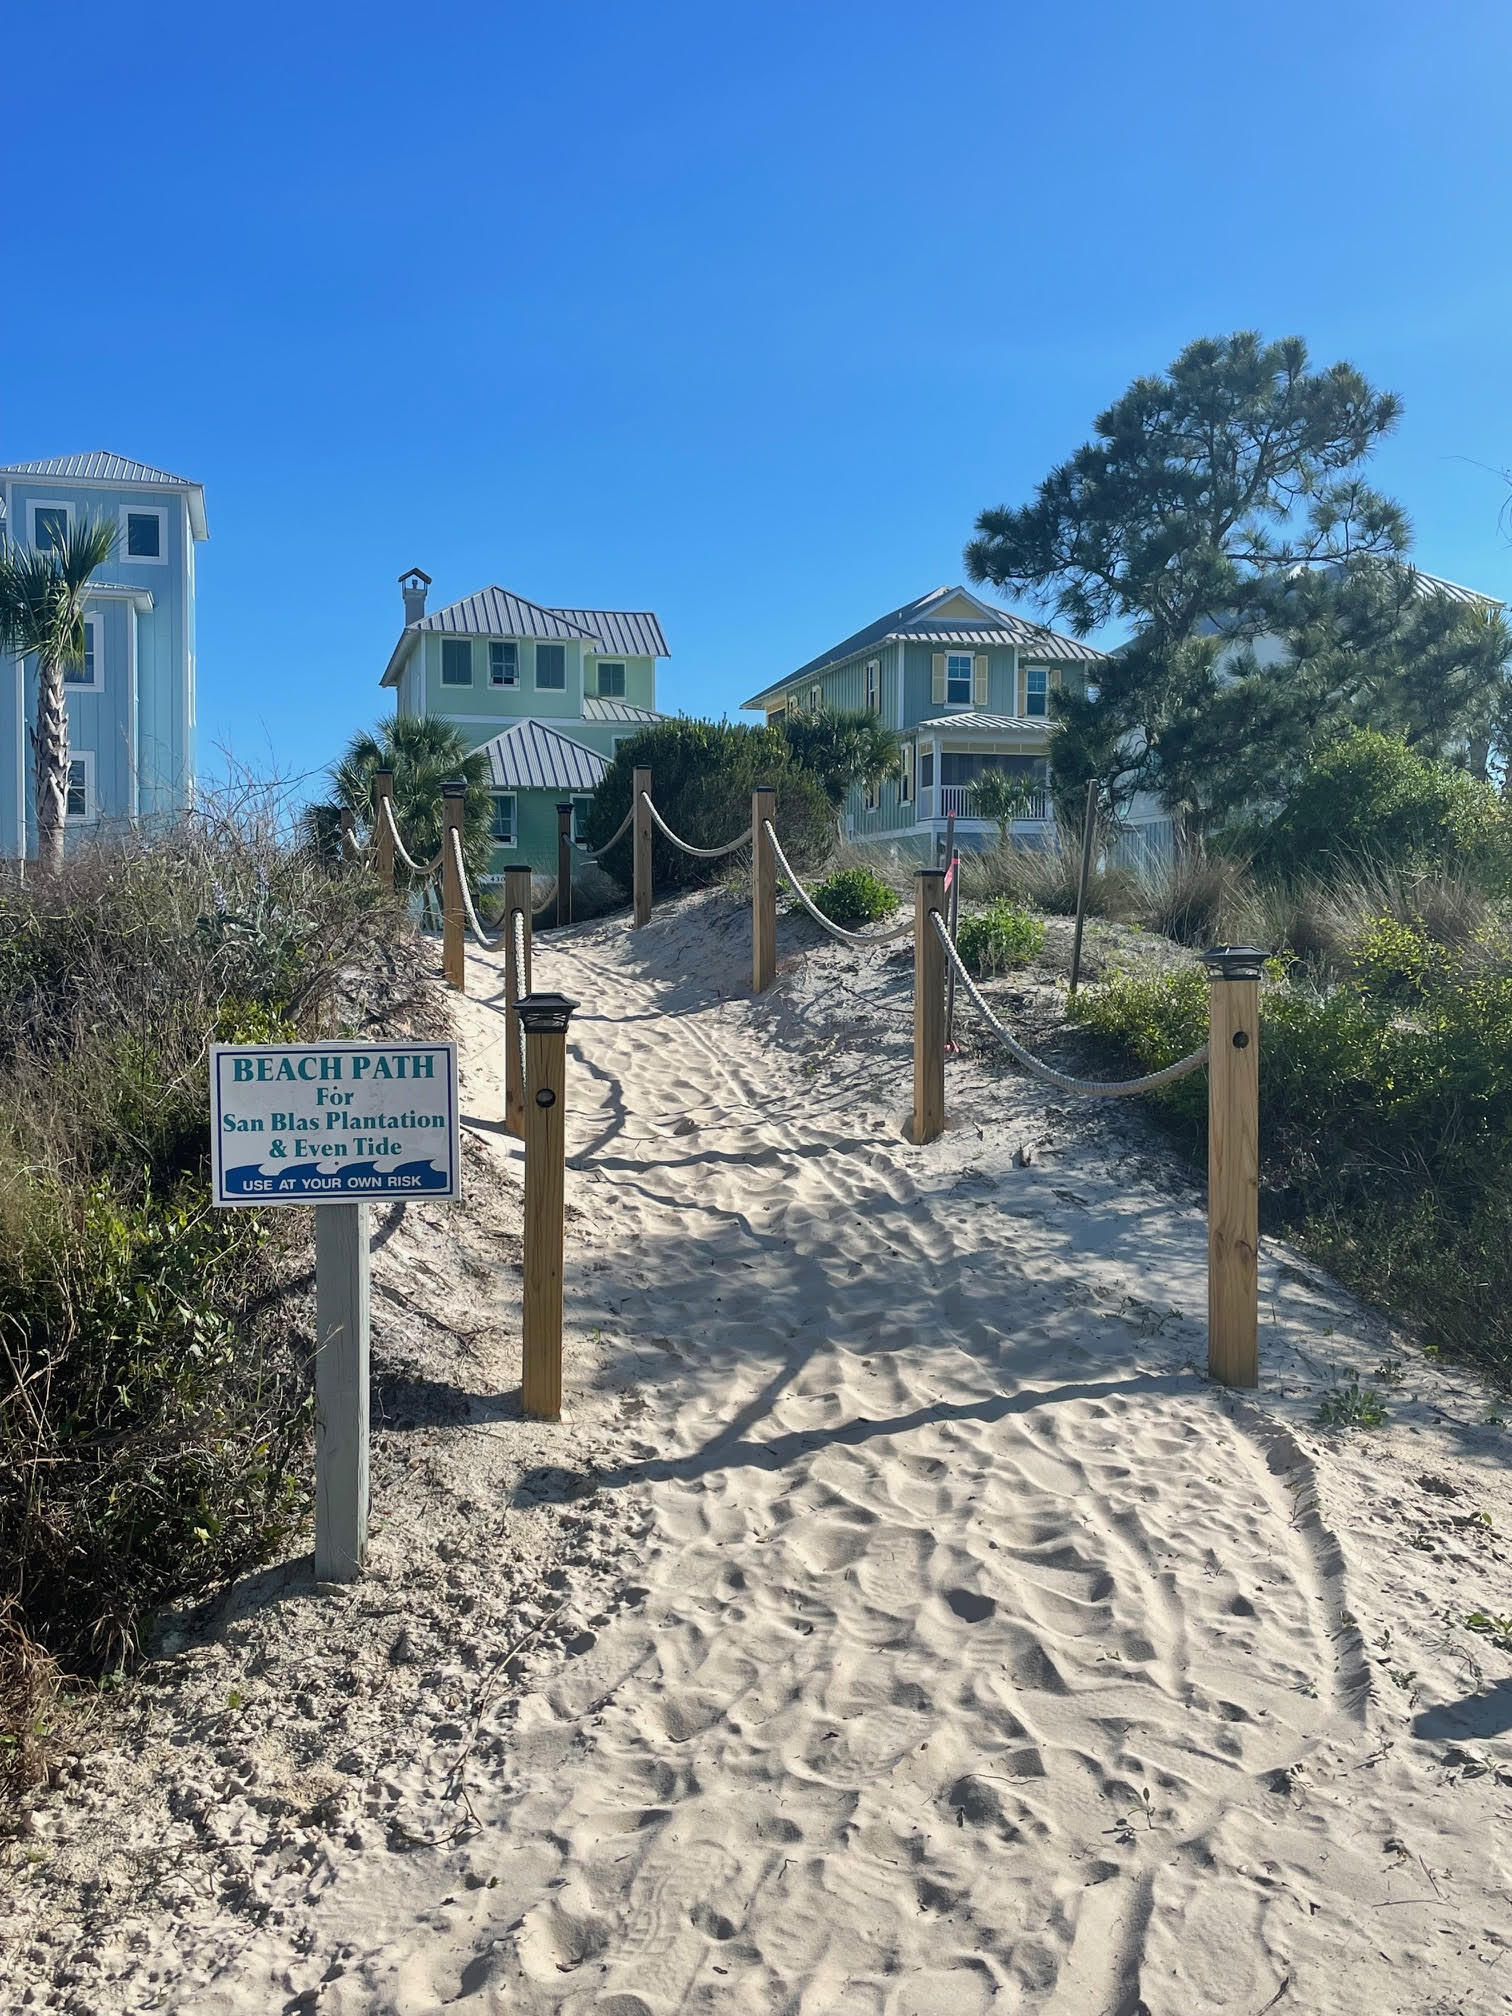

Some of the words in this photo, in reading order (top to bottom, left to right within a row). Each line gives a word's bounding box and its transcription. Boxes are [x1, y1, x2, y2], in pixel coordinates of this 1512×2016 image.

[232, 1056, 342, 1082] BEACH
[351, 1055, 435, 1079] PATH
[316, 1086, 354, 1106] For
[223, 1113, 264, 1132] San
[271, 1112, 319, 1131] Blas
[326, 1110, 445, 1130] Plantation
[269, 1139, 287, 1158] &
[294, 1138, 347, 1157] Even
[353, 1136, 402, 1155] Tide
[242, 1180, 273, 1191] USE
[278, 1179, 296, 1190] AT
[301, 1178, 342, 1189] YOUR
[347, 1177, 382, 1188] OWN
[387, 1175, 421, 1187] RISK
